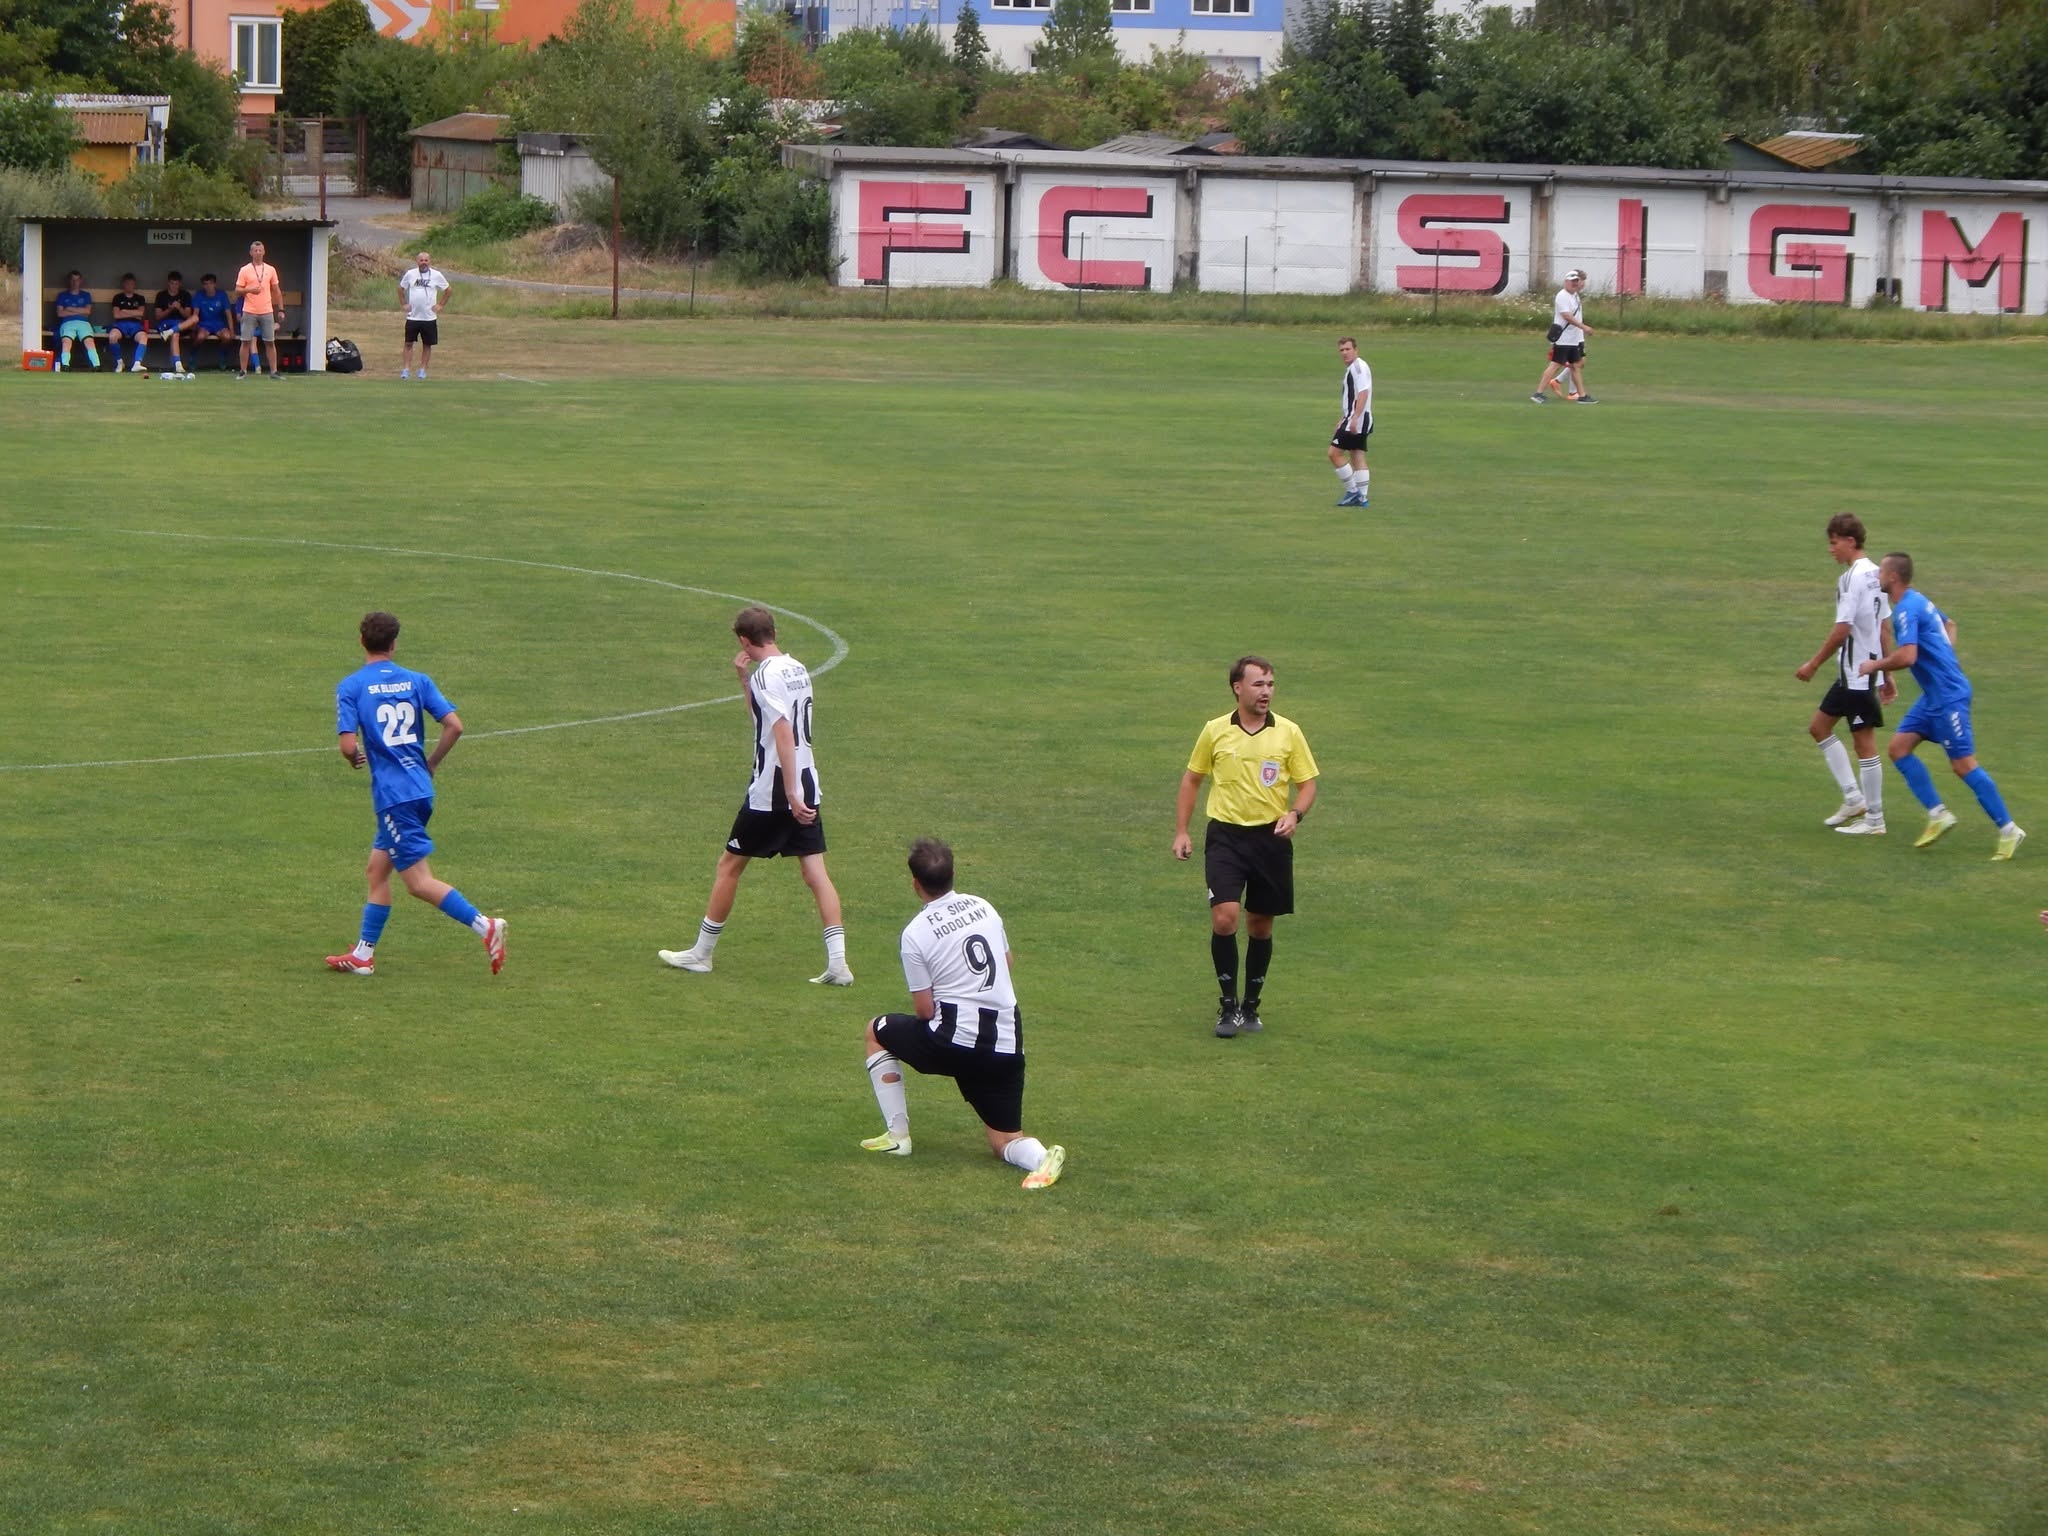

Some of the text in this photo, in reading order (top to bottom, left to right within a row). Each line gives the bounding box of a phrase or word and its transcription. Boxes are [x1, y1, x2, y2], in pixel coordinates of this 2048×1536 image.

[858, 181, 2029, 312] FC SIGM
[367, 681, 412, 695] SK BLUDOV
[376, 701, 418, 747] 22
[791, 696, 813, 750] 10
[926, 897, 979, 925] FC SIGMA
[932, 906, 988, 940] HODOLANY
[961, 932, 997, 993] 9
